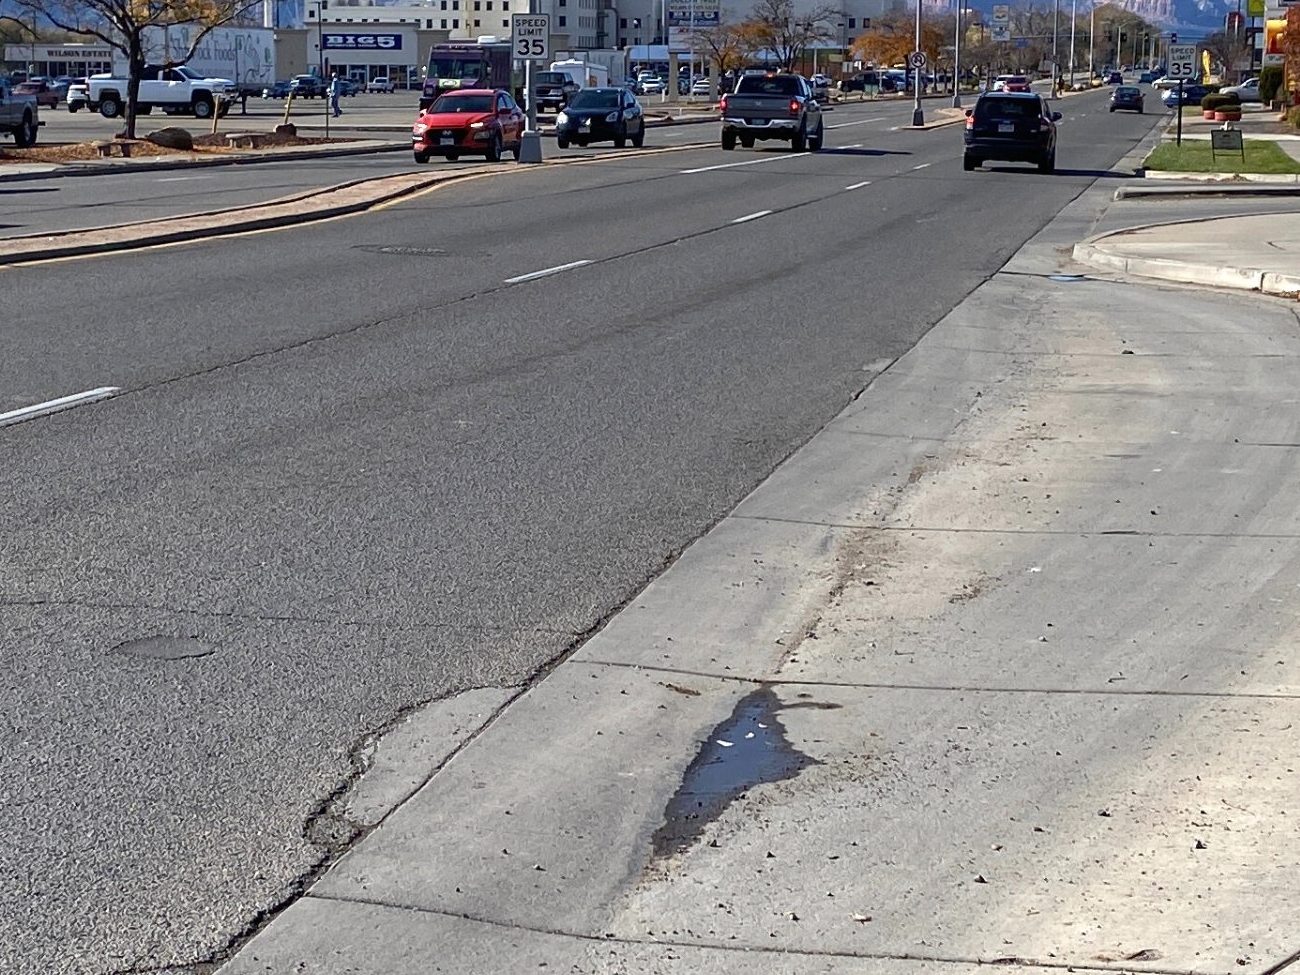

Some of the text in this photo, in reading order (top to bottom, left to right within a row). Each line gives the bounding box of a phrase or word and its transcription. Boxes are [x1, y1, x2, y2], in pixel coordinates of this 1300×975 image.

[515, 19, 547, 27] SPEED
[518, 28, 543, 36] LIMIT
[326, 35, 396, 48] BIG 5
[517, 39, 545, 56] 35
[47, 50, 80, 58] WILSON
[214, 40, 236, 61] Foods
[1170, 62, 1193, 76] 35
